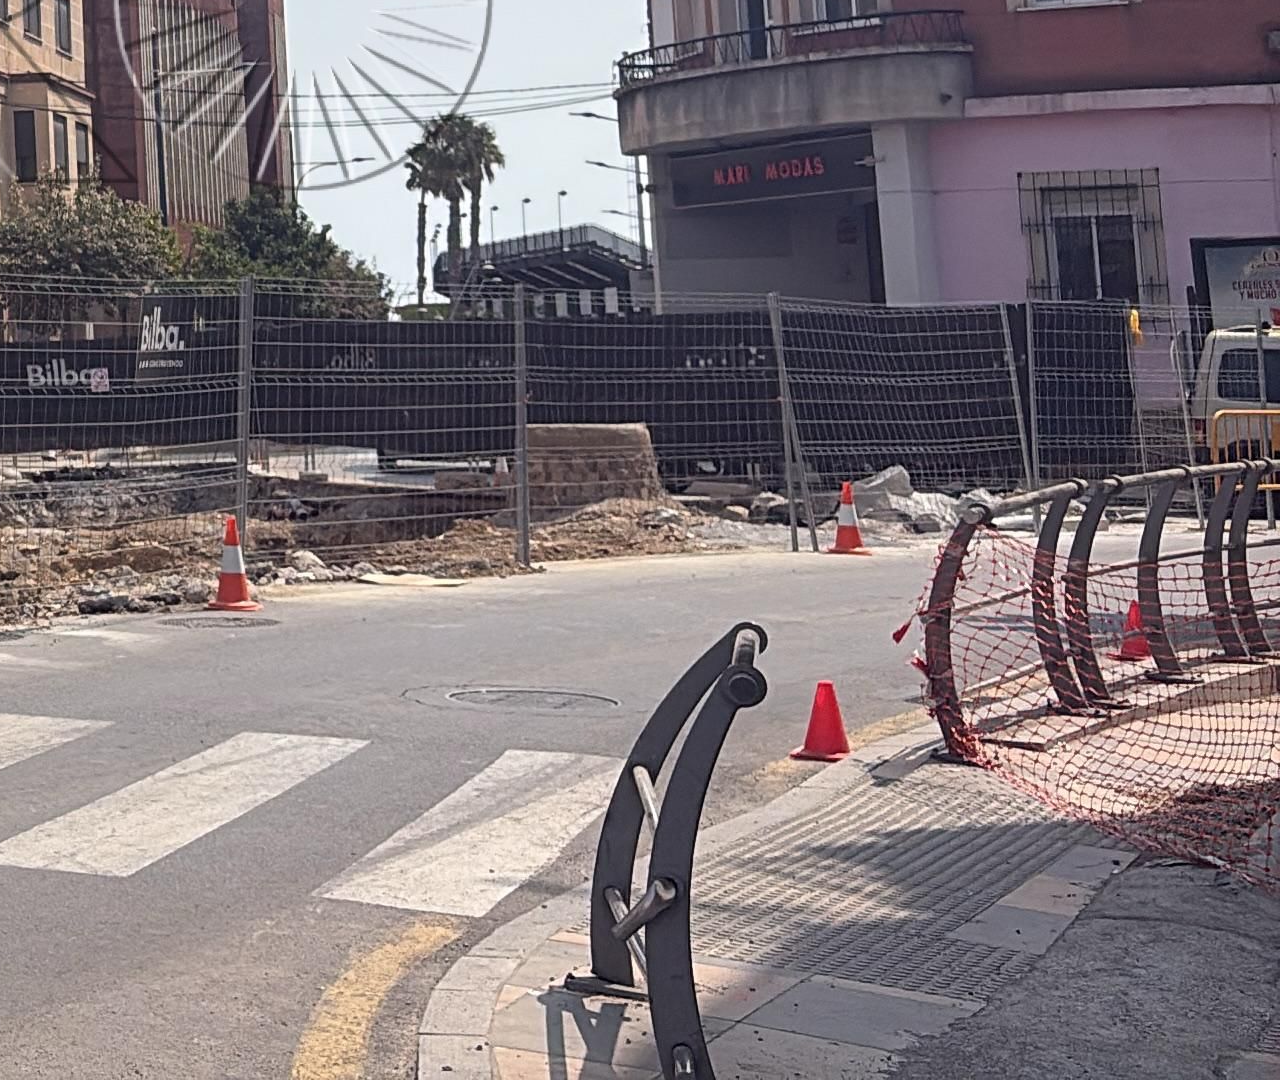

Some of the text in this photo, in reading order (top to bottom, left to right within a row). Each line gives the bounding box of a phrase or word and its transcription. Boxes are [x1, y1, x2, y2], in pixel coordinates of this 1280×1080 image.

[714, 156, 825, 185] MARI MODAS
[1247, 289, 1277, 300] MUCHO
